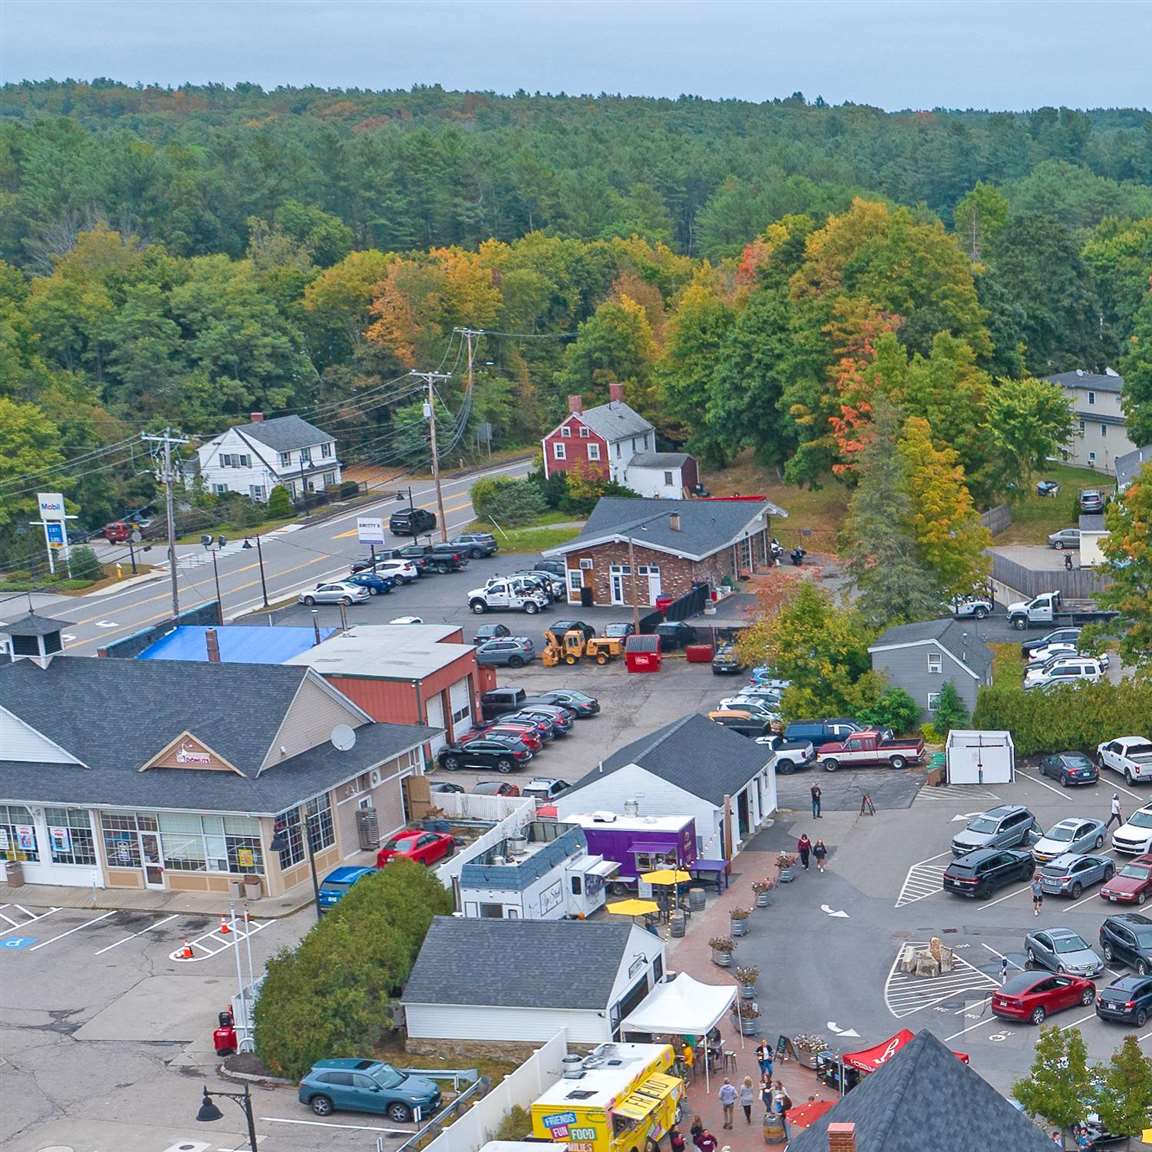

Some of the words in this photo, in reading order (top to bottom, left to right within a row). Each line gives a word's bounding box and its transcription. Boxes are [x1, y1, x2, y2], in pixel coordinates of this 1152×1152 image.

[41, 503, 61, 511] Mobil
[543, 1113, 576, 1128] FRIENDS
[552, 1126, 569, 1139] FUN
[570, 1128, 596, 1141] FOOD
